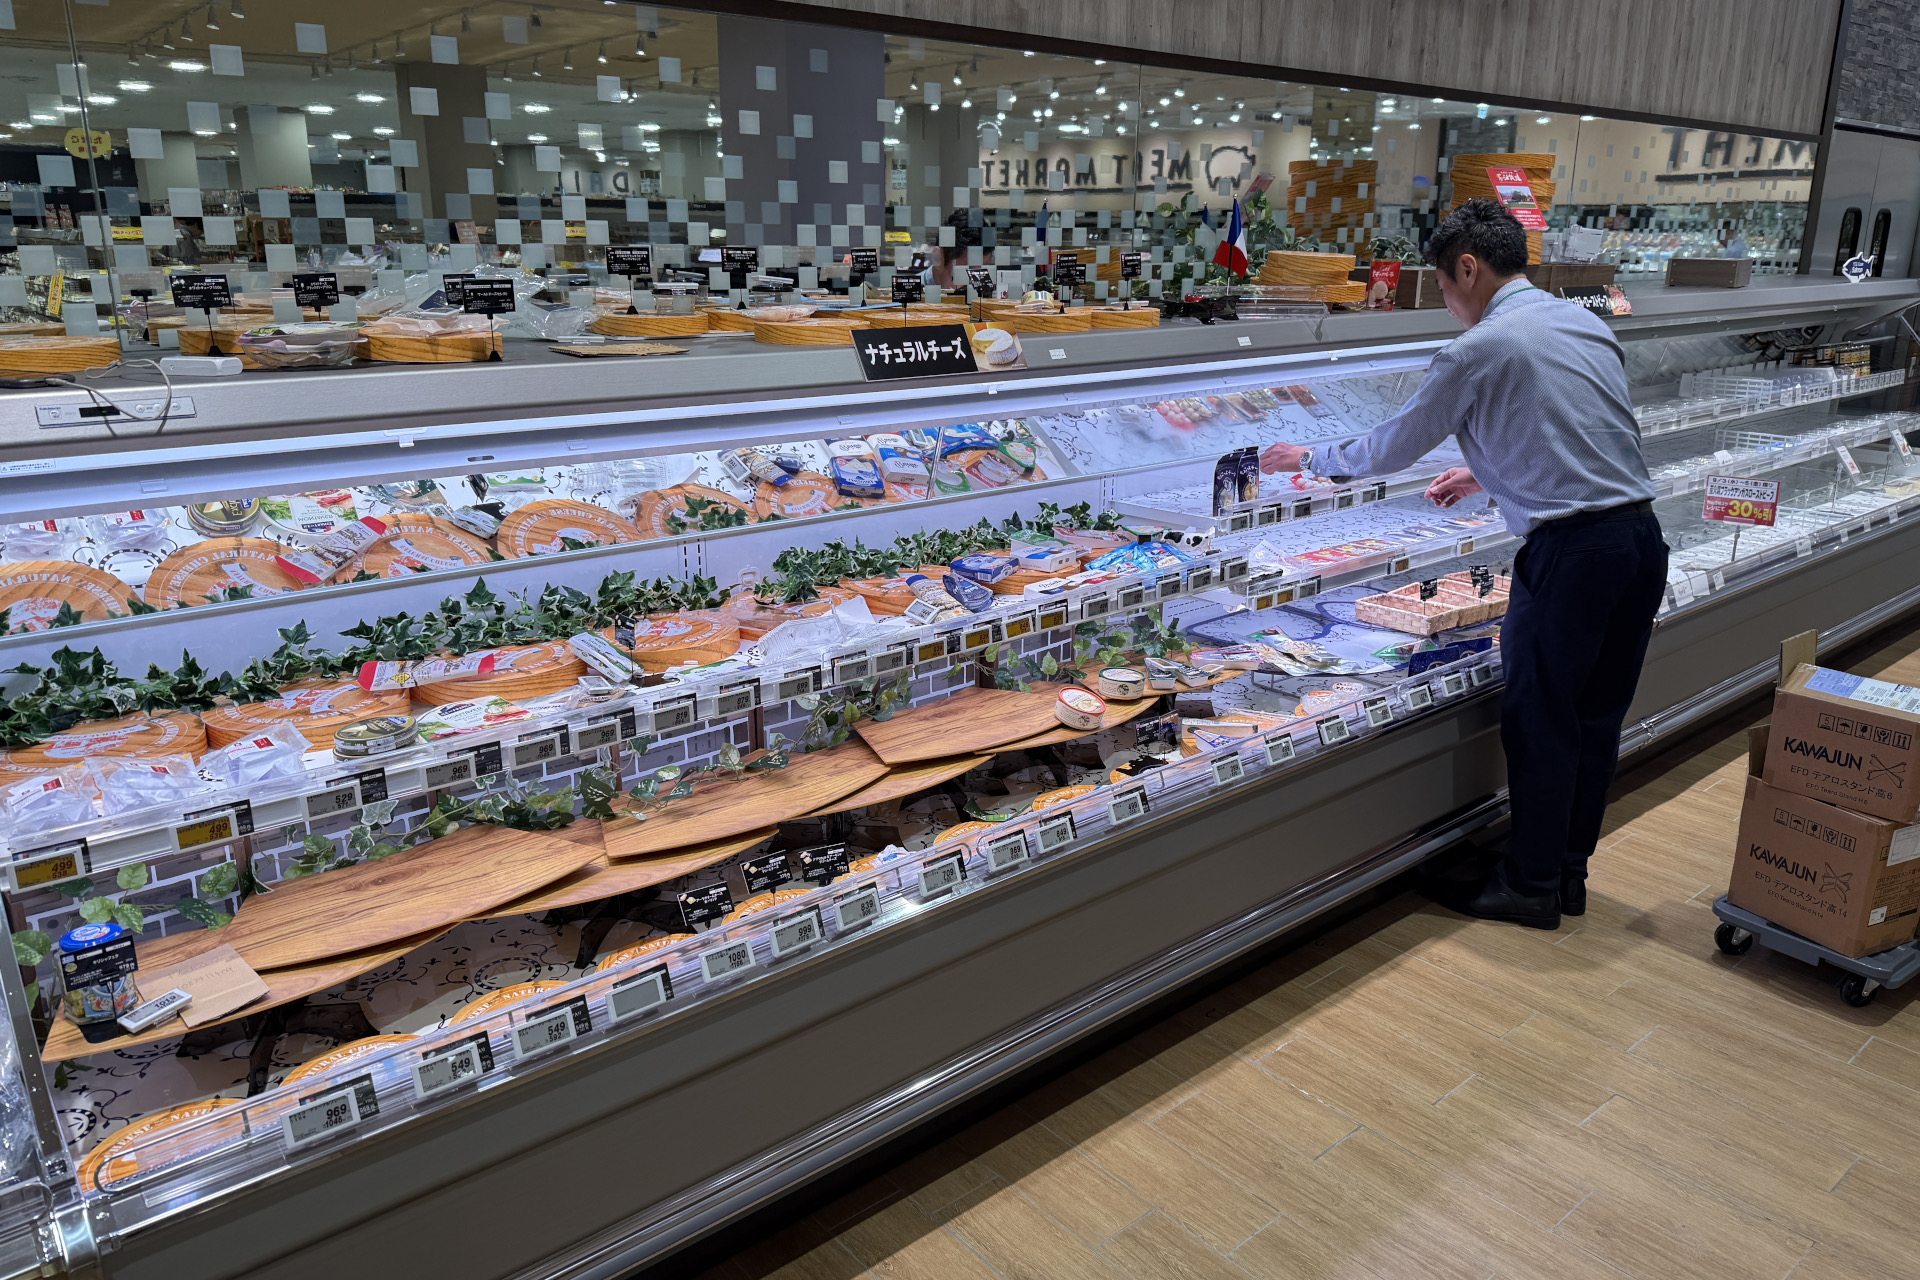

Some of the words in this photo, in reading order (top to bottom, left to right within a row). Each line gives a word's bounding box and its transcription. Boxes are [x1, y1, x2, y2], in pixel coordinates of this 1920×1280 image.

[865, 336, 967, 366] ナチュラルチーズ
[601, 729, 614, 738] 969
[539, 744, 553, 754] 969
[1784, 736, 1863, 772] KAWAJUN
[452, 765, 468, 775] 969
[1790, 764, 1809, 776] EFD
[335, 792, 353, 804] 529
[1839, 791, 1857, 802] Stand
[1128, 802, 1138, 811] 499
[209, 823, 228, 835] 499
[209, 831, 224, 841] 538
[52, 860, 73, 873] 499
[1750, 843, 1818, 885] KAWAJUN
[52, 869, 68, 880] 538
[942, 866, 954, 878] 709
[1754, 870, 1771, 884] EFD
[1838, 908, 1848, 918] 14
[860, 900, 873, 912] 839
[1795, 900, 1812, 914] Stand
[798, 924, 812, 937] 999
[729, 950, 746, 964] 1080
[547, 1021, 566, 1036] 549
[549, 1032, 562, 1042] 592
[451, 1057, 470, 1073] 549
[326, 1104, 347, 1119] 969
[325, 1116, 343, 1128] 1046
